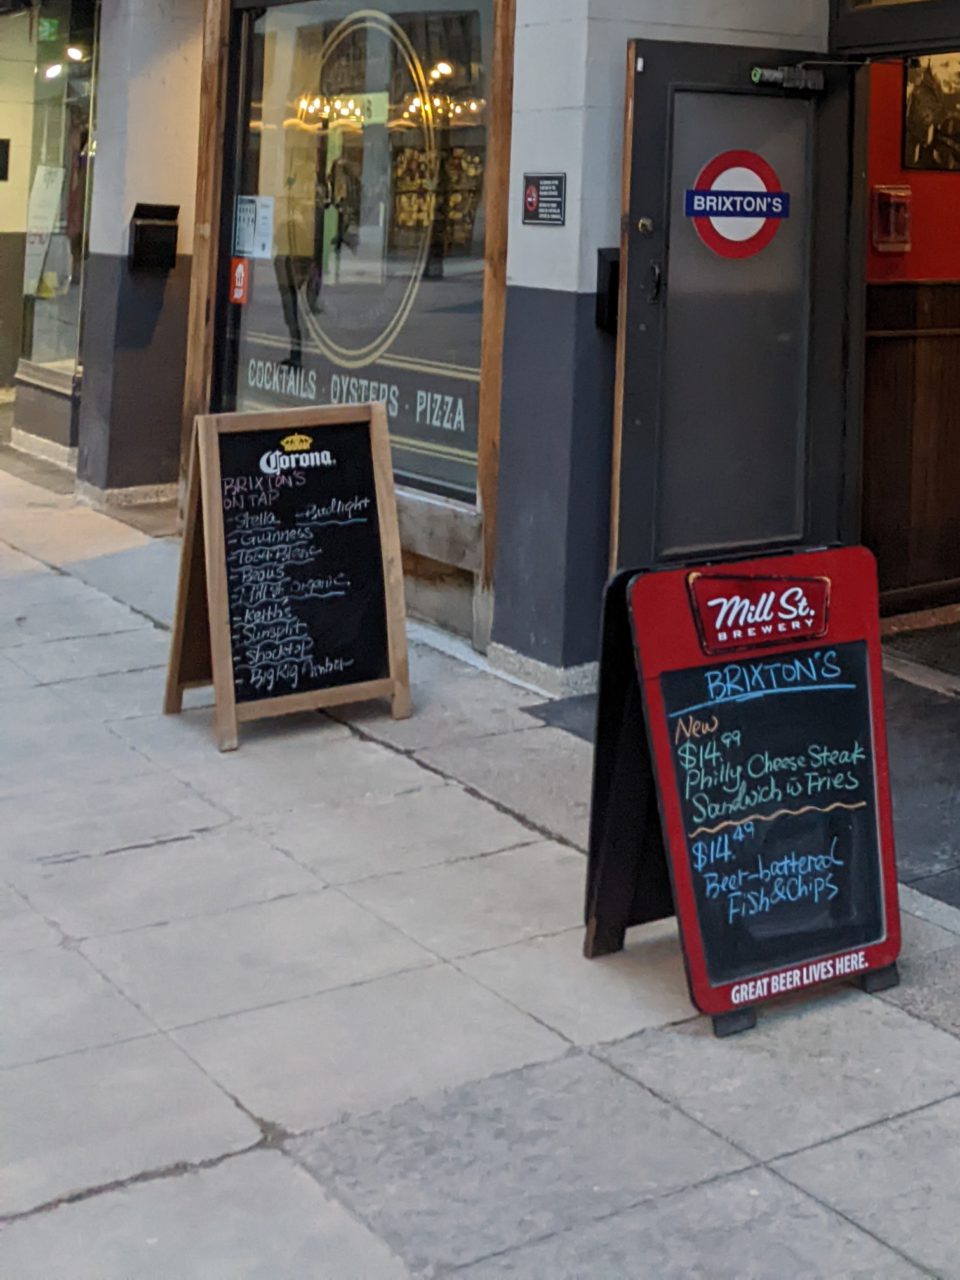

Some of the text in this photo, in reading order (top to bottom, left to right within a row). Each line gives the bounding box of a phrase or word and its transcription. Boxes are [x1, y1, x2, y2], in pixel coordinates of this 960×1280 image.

[693, 195, 783, 213] BRIXTON'S
[248, 358, 317, 400] COCKTAILS
[416, 390, 465, 432] PIZZA
[259, 450, 333, 475] Corona
[223, 471, 306, 495] BRIXTON'S
[707, 587, 816, 629] Mill St.
[718, 619, 815, 641] BREWERY
[704, 651, 841, 699] BRIXTON'S
[675, 715, 719, 745] New
[685, 764, 743, 800] Philly
[692, 776, 783, 823] Sandwich
[805, 770, 860, 795] Fries
[731, 951, 869, 1004] GREAT BEER LIVES HERE.
